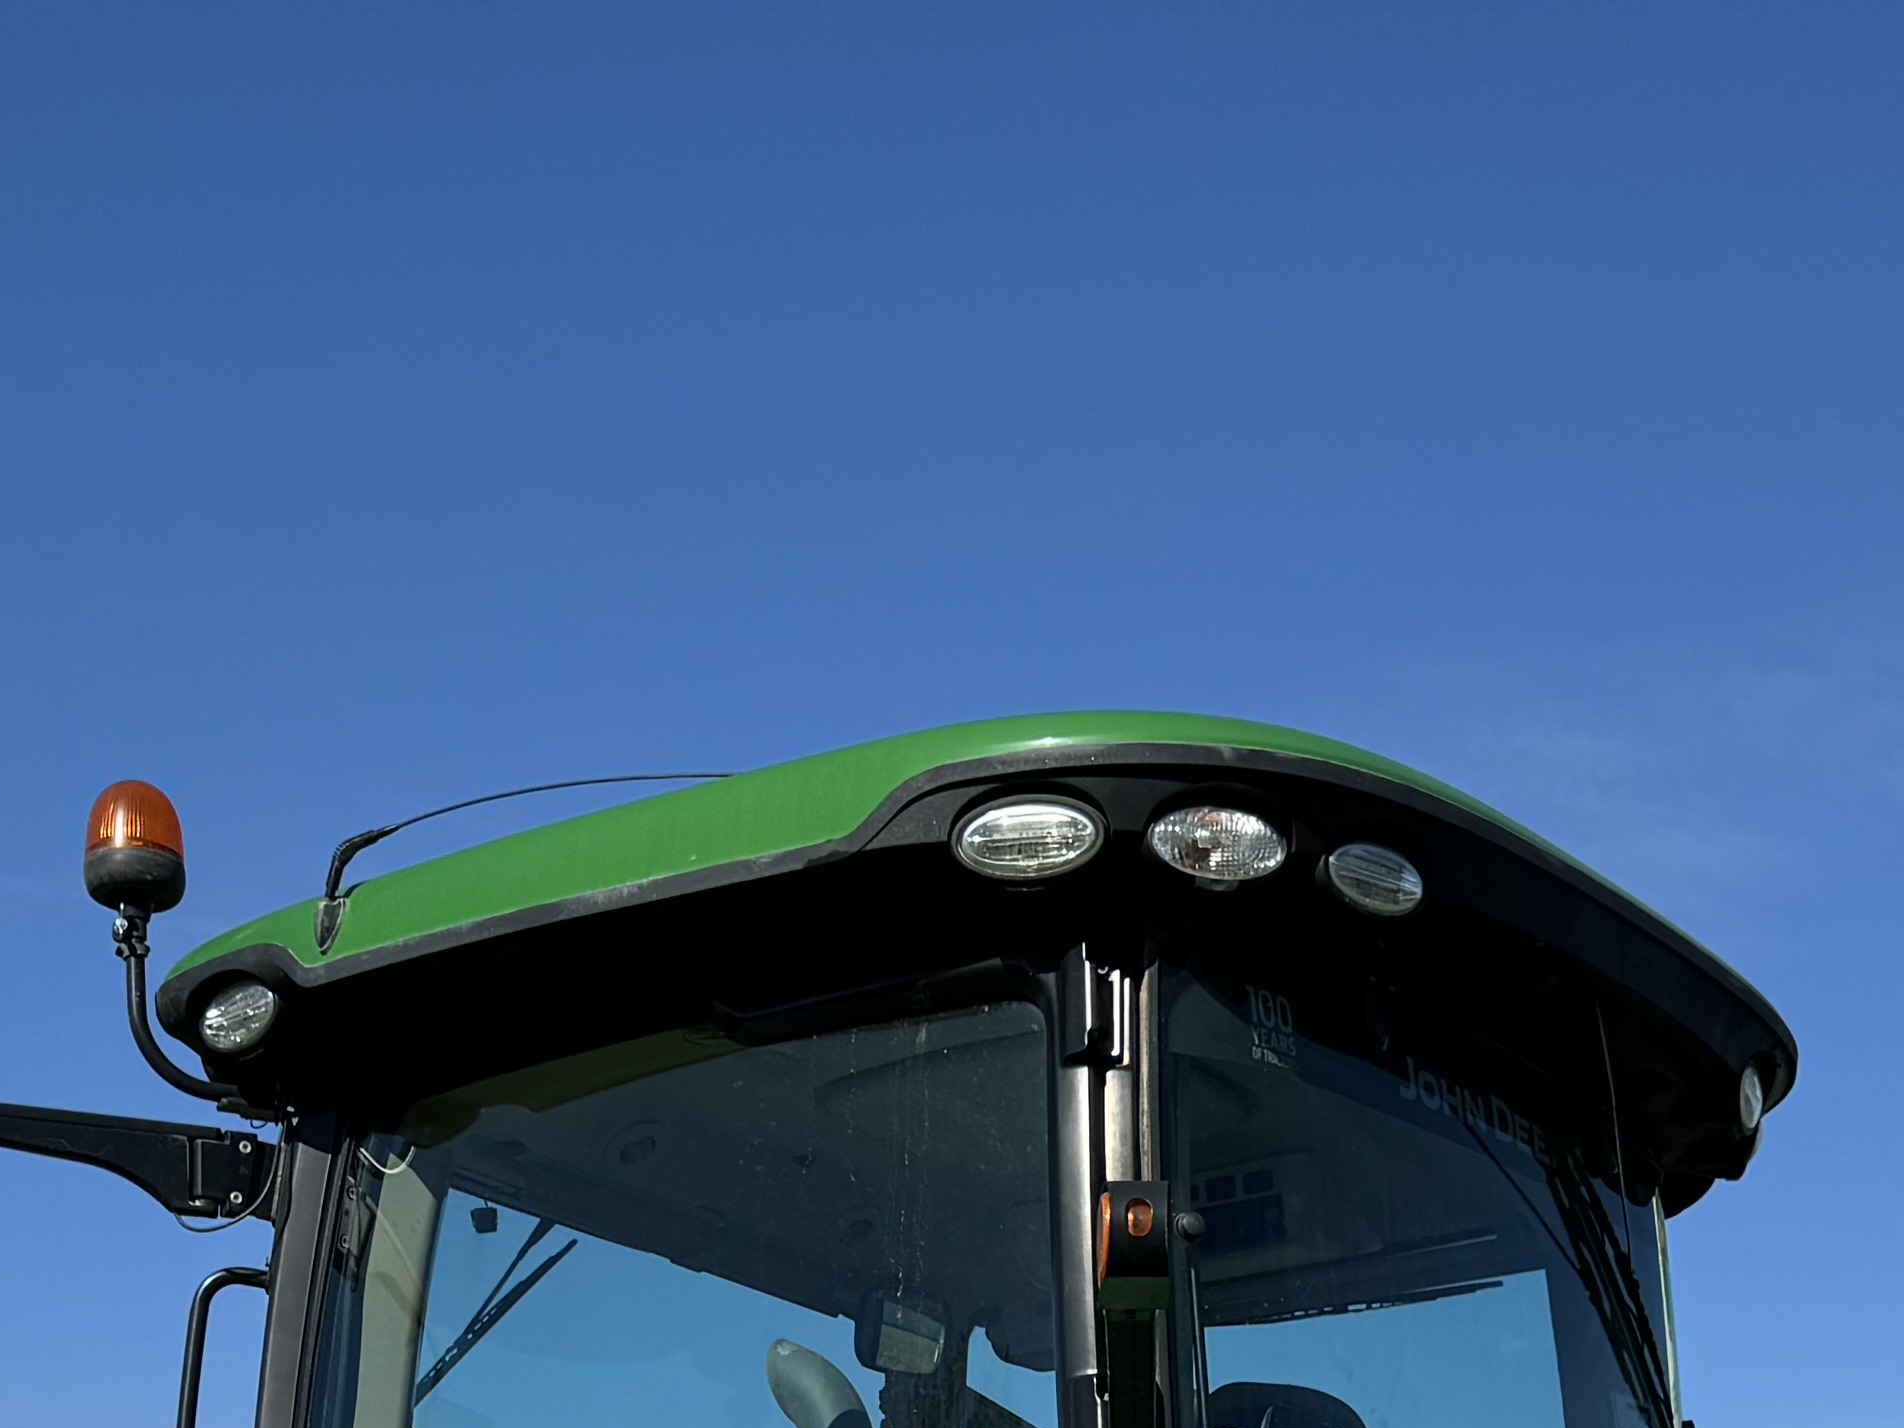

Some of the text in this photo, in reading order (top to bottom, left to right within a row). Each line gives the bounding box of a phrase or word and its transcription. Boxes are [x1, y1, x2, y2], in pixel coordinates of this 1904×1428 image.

[1246, 985, 1293, 1034] 100
[1250, 1026, 1297, 1057] YEARS
[1399, 1056, 1586, 1175] JOHN DEE
